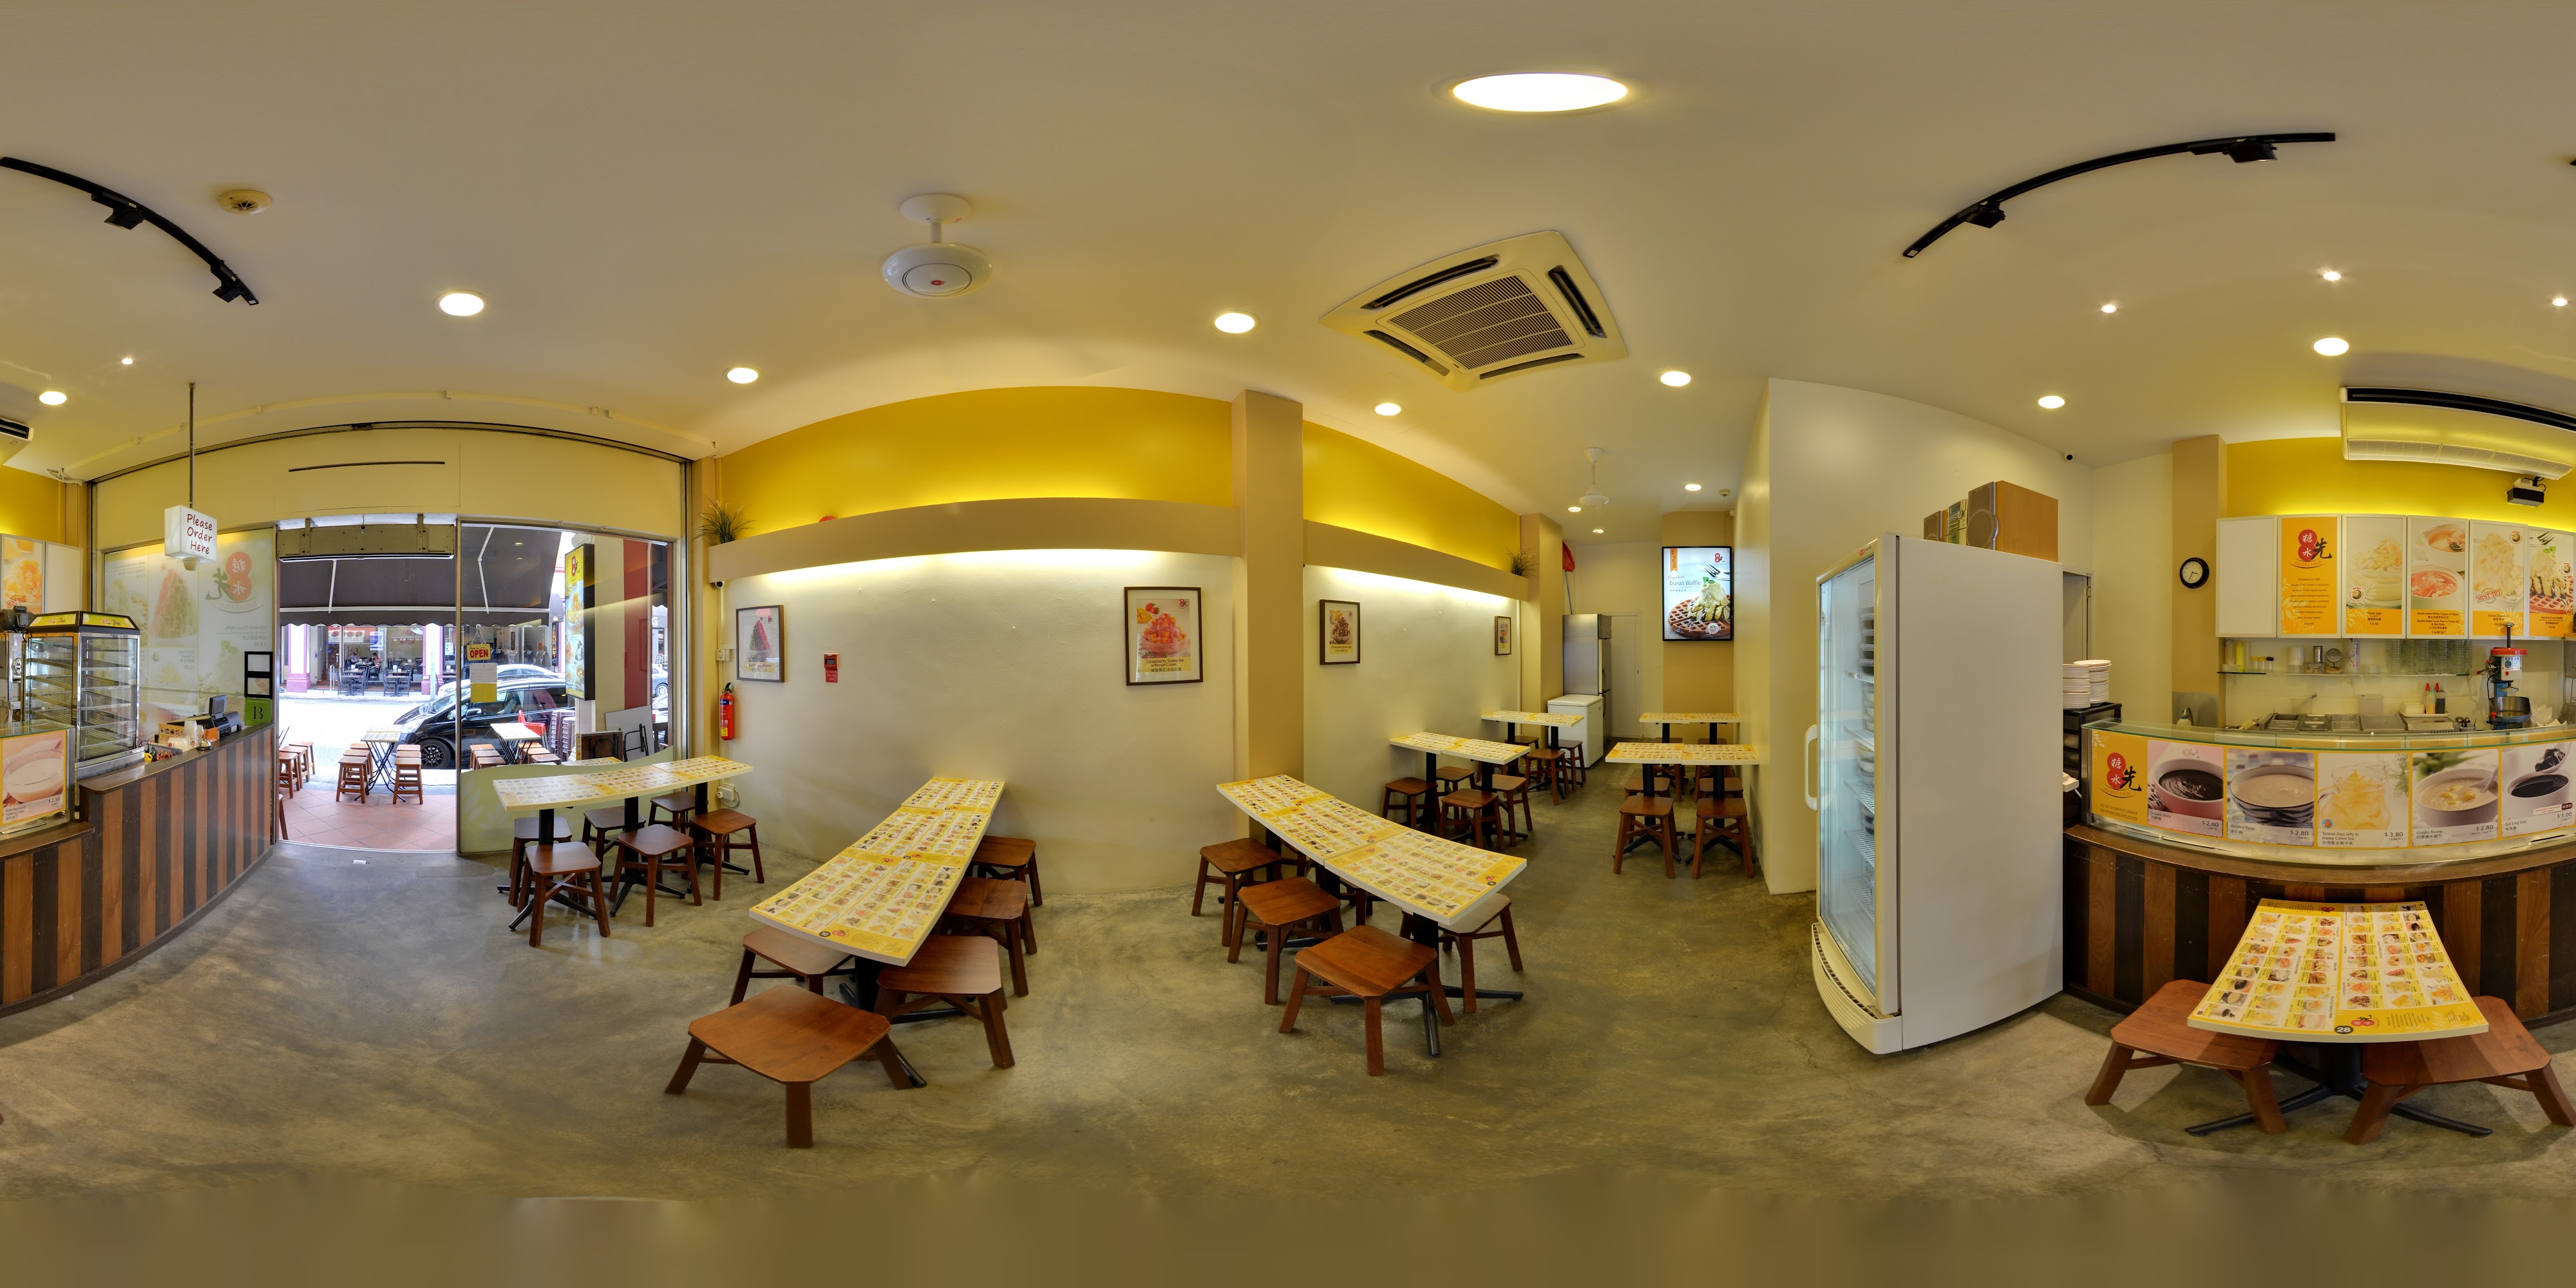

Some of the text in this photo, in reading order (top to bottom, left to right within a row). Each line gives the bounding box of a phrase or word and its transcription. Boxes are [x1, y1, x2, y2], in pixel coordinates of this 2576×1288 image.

[187, 513, 213, 531] Please
[187, 527, 213, 542] Order
[191, 540, 209, 554] Here
[470, 649, 488, 658] OPEN
[253, 706, 263, 720] B
